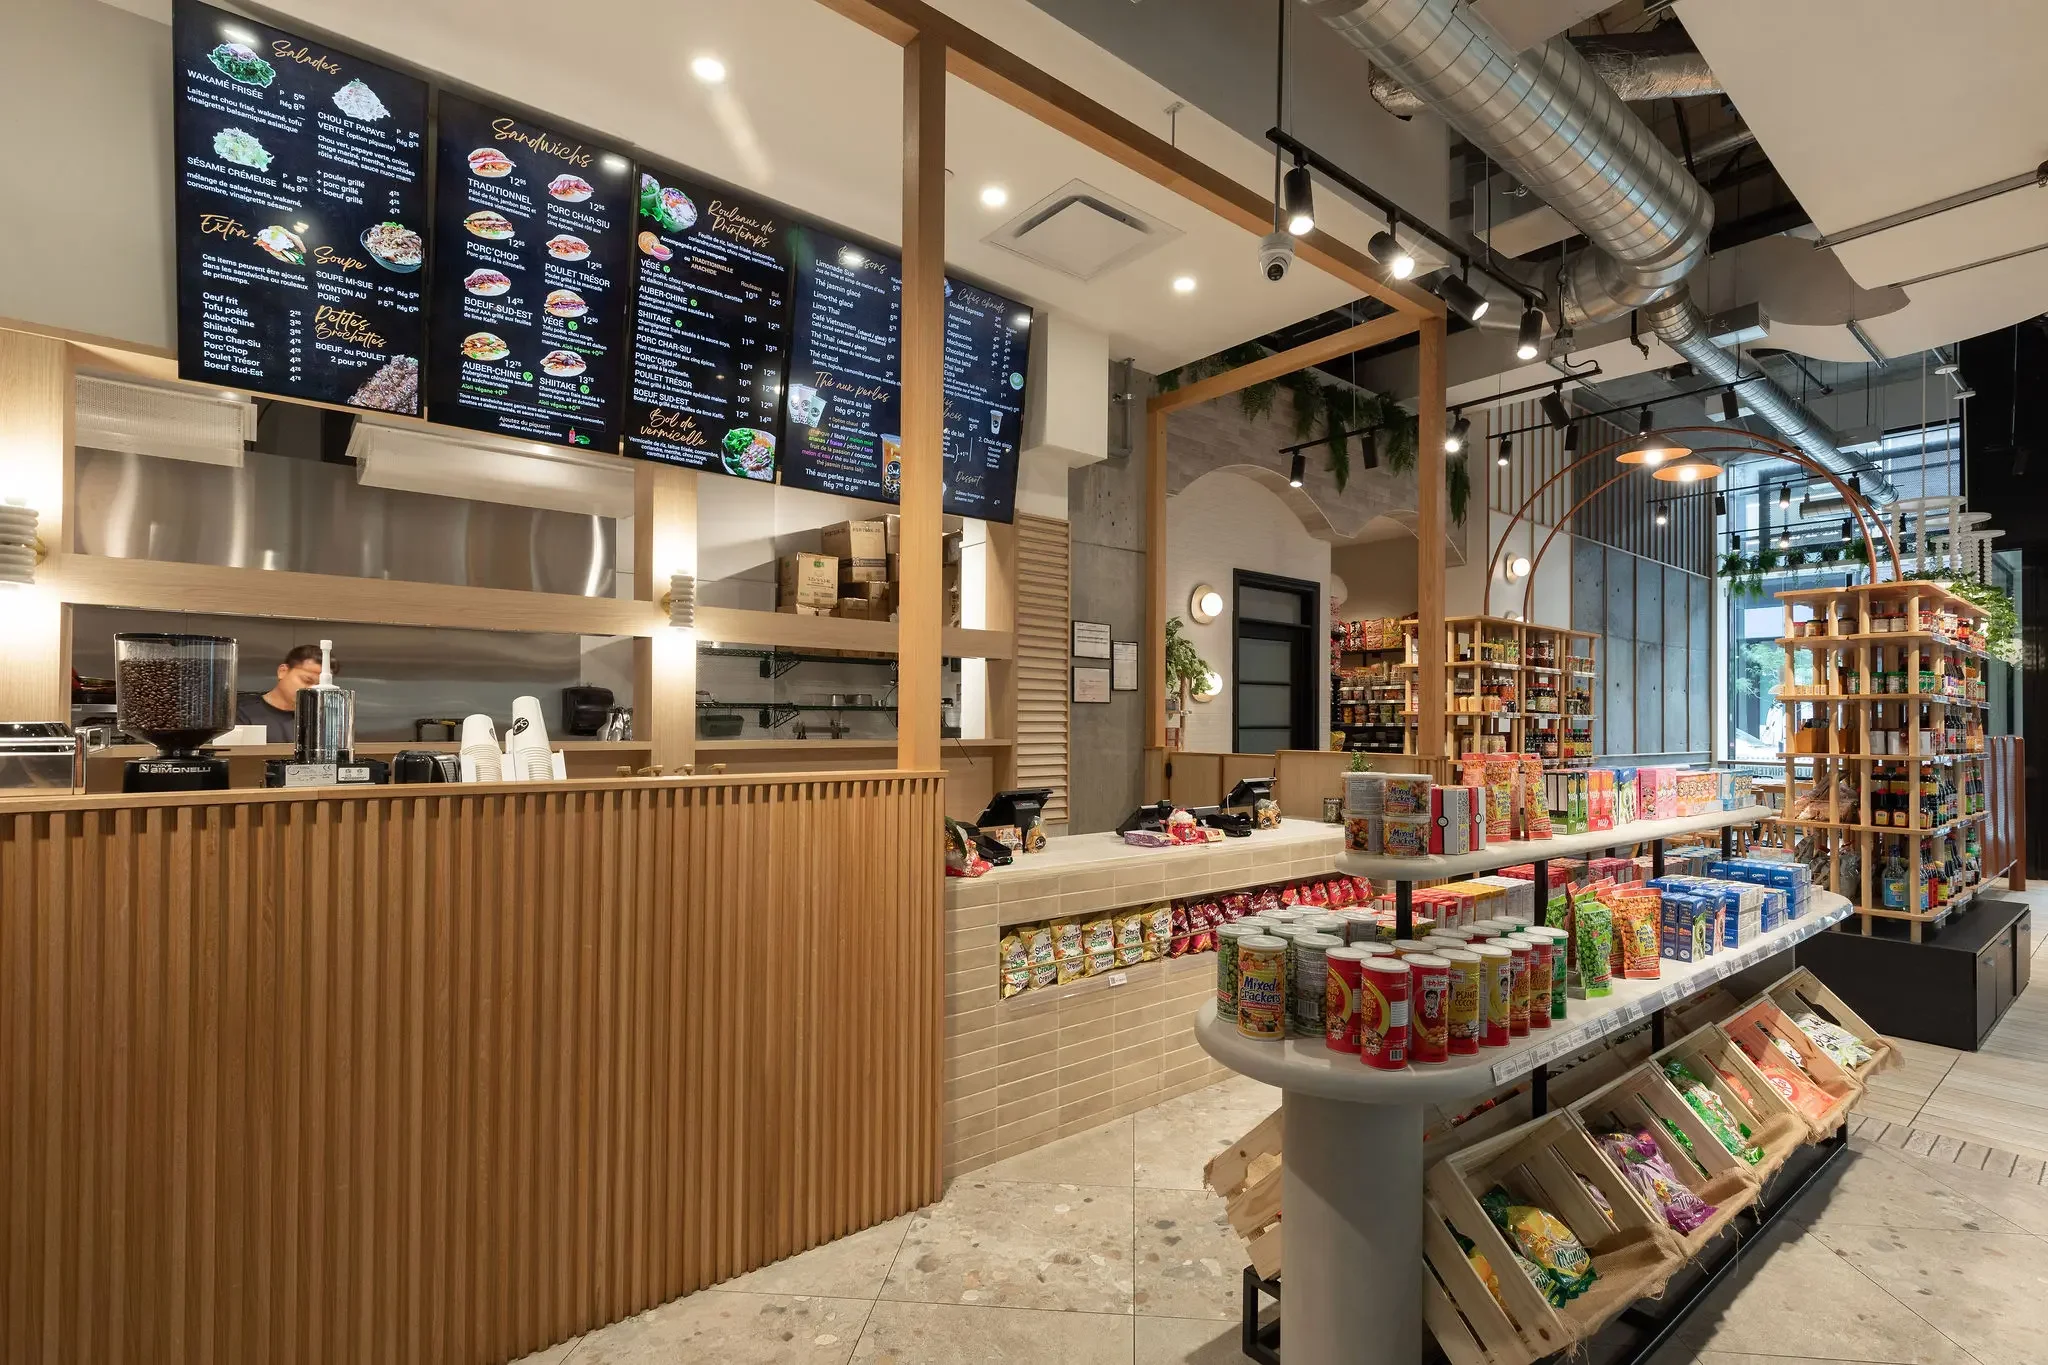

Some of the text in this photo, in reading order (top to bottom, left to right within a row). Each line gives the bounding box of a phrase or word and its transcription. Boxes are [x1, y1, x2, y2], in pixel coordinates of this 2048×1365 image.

[272, 40, 341, 74] Salades
[187, 70, 264, 100] WAKAMÉ FRISÉE
[187, 87, 210, 98] Laitue
[220, 96, 238, 107] chou
[288, 117, 302, 127] tofu
[187, 95, 298, 134] vinaigrette balsamique asiatique
[318, 112, 386, 138] CHOU ET PAPAYE
[318, 121, 344, 136] VERTE
[346, 130, 368, 143] (option
[318, 135, 335, 145] Chou
[492, 118, 594, 168] Sandwichs
[186, 156, 277, 188] SÉSAME CRÉMEUSE
[324, 172, 366, 189] poulet grillé
[186, 172, 252, 194] mélange salade
[324, 180, 359, 196] porc grillé
[468, 178, 532, 205] TRADITIONNEL
[229, 190, 266, 206] vinaigrette
[266, 200, 292, 212] sésame
[346, 195, 364, 206] grillé
[547, 203, 610, 229] PORC CHAR-SIU
[200, 214, 250, 241] Extra
[712, 216, 770, 248] Printemps
[761, 221, 776, 235] de
[202, 254, 216, 262] Ces
[218, 258, 237, 266] items
[238, 262, 266, 274] peuvent
[314, 246, 368, 272] Soupe
[640, 259, 660, 271] VÉGÉ
[816, 259, 855, 277] Limonade Sue
[202, 262, 220, 271] dans
[233, 268, 270, 282] sandwichs
[280, 279, 308, 290] rouleaux
[316, 270, 374, 290] SOUPE MI-SUE
[545, 263, 610, 288] POULET TRÉSOR
[317, 282, 367, 300] WONTON AU
[318, 292, 340, 302] PORC
[639, 285, 688, 305] AUBER-CHINE
[815, 278, 861, 298] Thé jasmin glacé
[203, 292, 239, 305] Oeuf frit
[813, 290, 854, 309] Limo-thé glacé
[813, 302, 827, 311] Limo
[203, 301, 248, 317] Tofu poêlé
[315, 305, 370, 331] Petites
[638, 309, 671, 325] SHIITAKE
[950, 301, 984, 318] Double Espresso
[203, 312, 255, 328] Auber-Chine
[203, 322, 238, 335] Shiitake
[542, 316, 564, 328] VÉGÉ
[812, 312, 856, 331] Café Vietnamien
[948, 314, 972, 325] Americano
[203, 331, 261, 348] Porc Char-Siu
[315, 322, 388, 348] Brochettes
[811, 330, 822, 339] Thé
[947, 330, 972, 342] Cappuccino
[316, 342, 386, 361] BOEUF ou POULET
[636, 334, 692, 354] PORC CHAR-SIU
[204, 351, 260, 367] Poulet Trésor
[338, 358, 355, 366] pour
[810, 350, 820, 358] Thé
[204, 360, 264, 377] Boeuf Sud-Est
[462, 361, 522, 380] AUBER-CHINE
[540, 377, 577, 391] SHIITAKE
[635, 369, 693, 389] POULET TRÉSOR
[816, 372, 835, 388] Thé
[855, 385, 891, 403] perles
[634, 388, 689, 406] BOEUF SUD-EST
[833, 396, 872, 410] Saveurs lait
[835, 406, 846, 415] Rég
[680, 416, 696, 431] de
[640, 426, 707, 447] vermicelle
[805, 468, 816, 477] Thé
[827, 472, 844, 482] perles
[1091, 940, 1108, 948] Chips
[1093, 930, 1112, 941] Shrimp
[1244, 976, 1277, 992] Mixed
[1241, 987, 1281, 1003] Crackers
